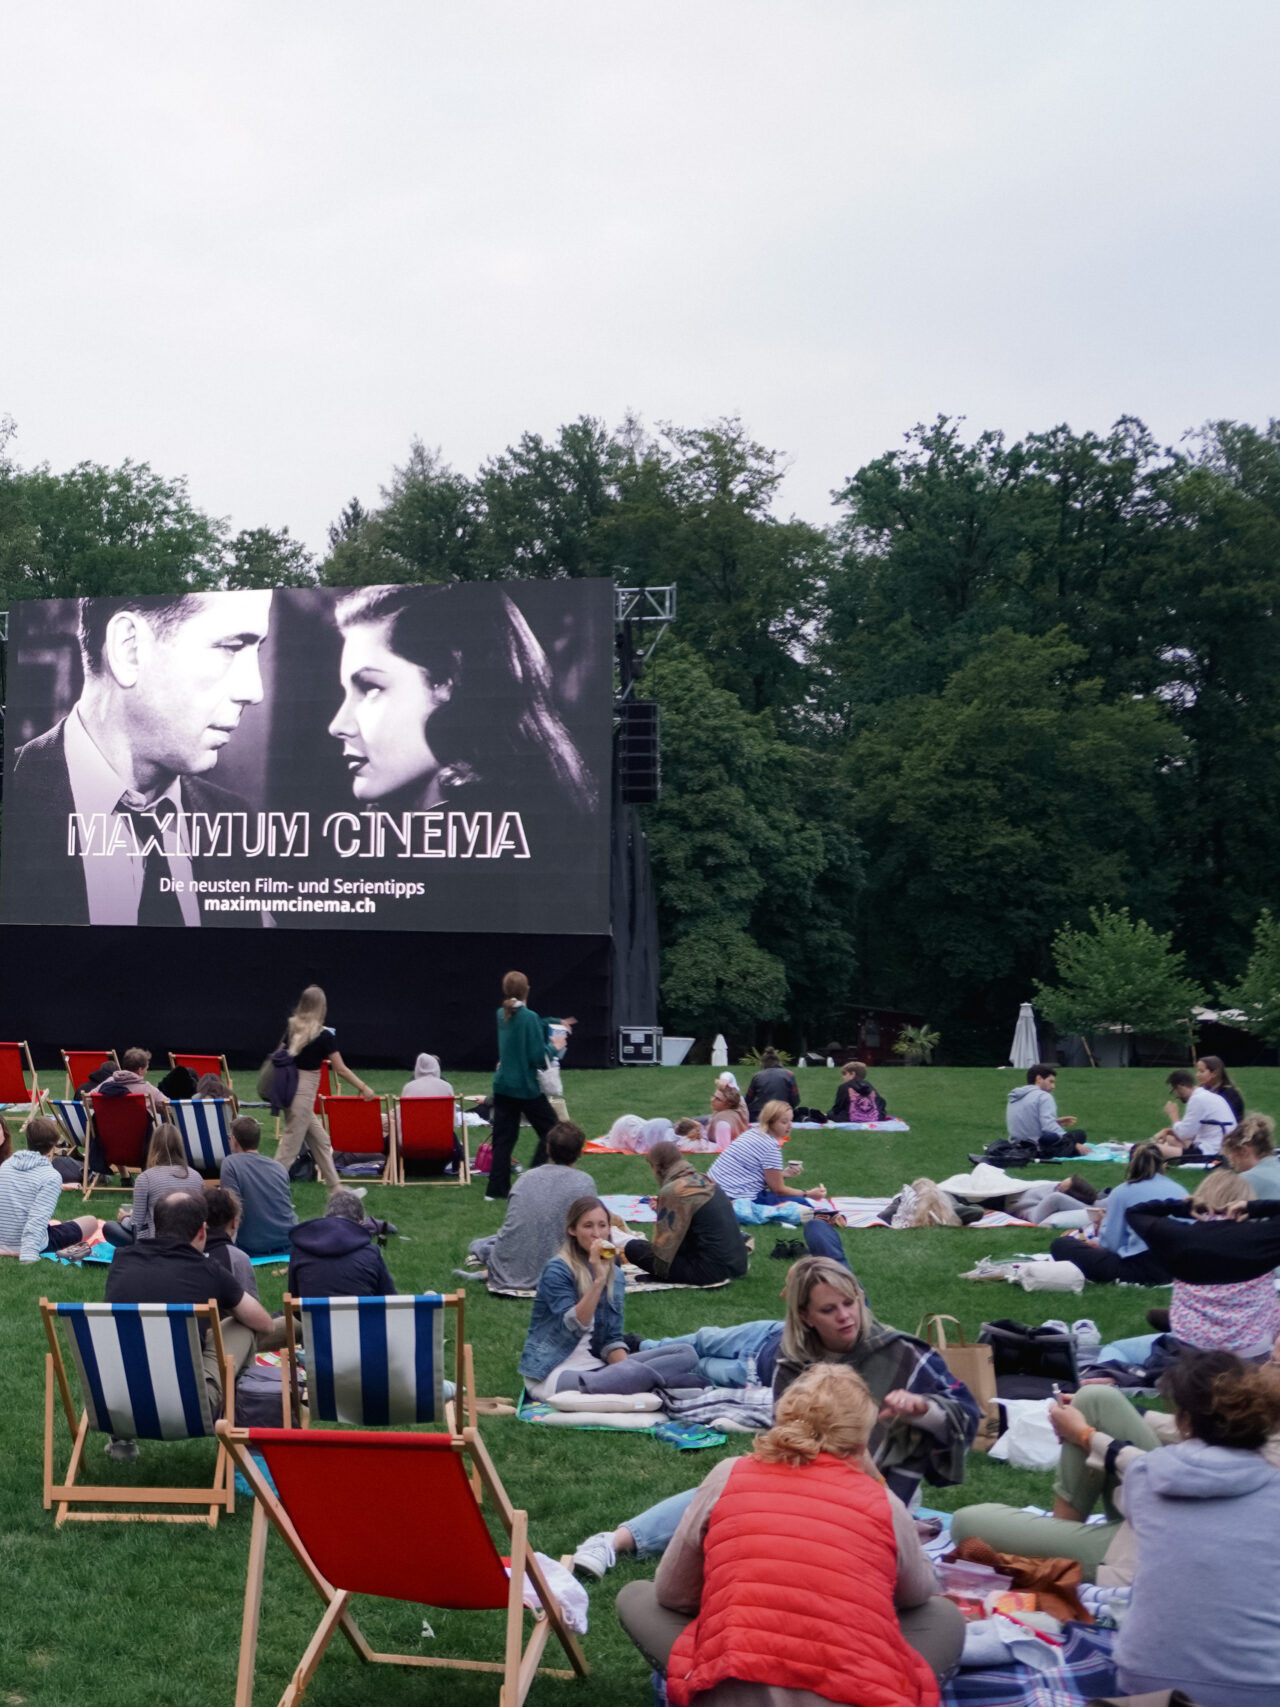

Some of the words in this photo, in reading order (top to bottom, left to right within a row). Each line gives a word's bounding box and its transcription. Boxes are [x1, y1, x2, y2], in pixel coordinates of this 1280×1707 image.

[67, 812, 310, 857] MAXIMUM
[322, 811, 531, 858] CINEMA
[160, 877, 185, 892] Die
[189, 879, 251, 893] neusten
[255, 877, 294, 893] Film-
[298, 878, 329, 894] und
[333, 879, 425, 899] Serientipps
[204, 896, 376, 913] maximumcinema.ch
